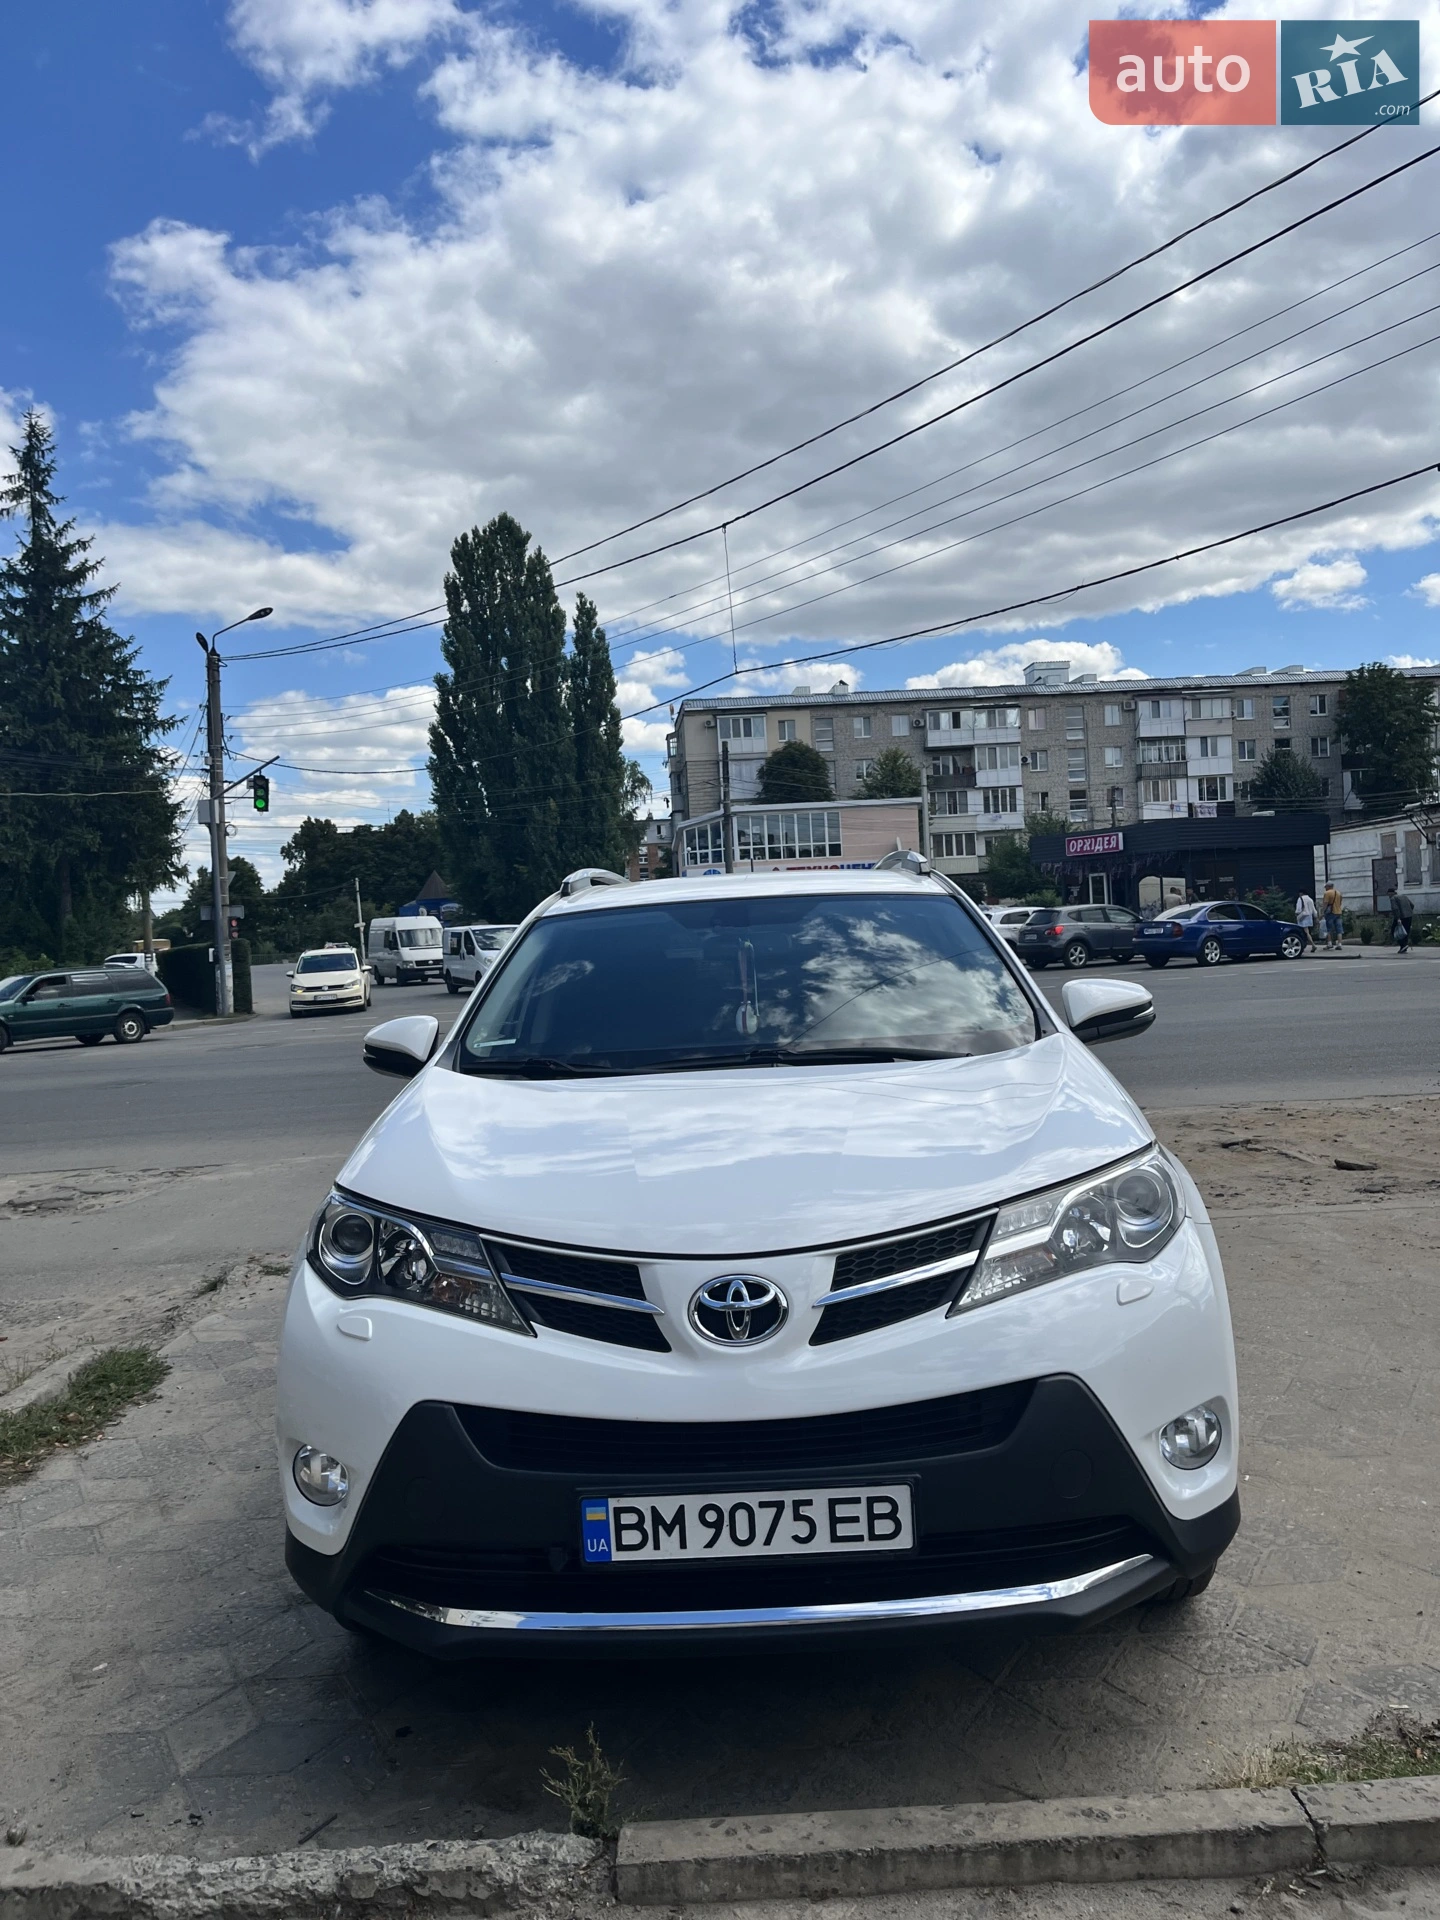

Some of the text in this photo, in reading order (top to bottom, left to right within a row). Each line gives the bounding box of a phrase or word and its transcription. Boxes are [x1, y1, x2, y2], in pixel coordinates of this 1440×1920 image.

[1069, 835, 1117, 853] ОРХІДЕЯ
[613, 1495, 903, 1552] BM 9075 EB
[587, 1538, 609, 1553] UA
